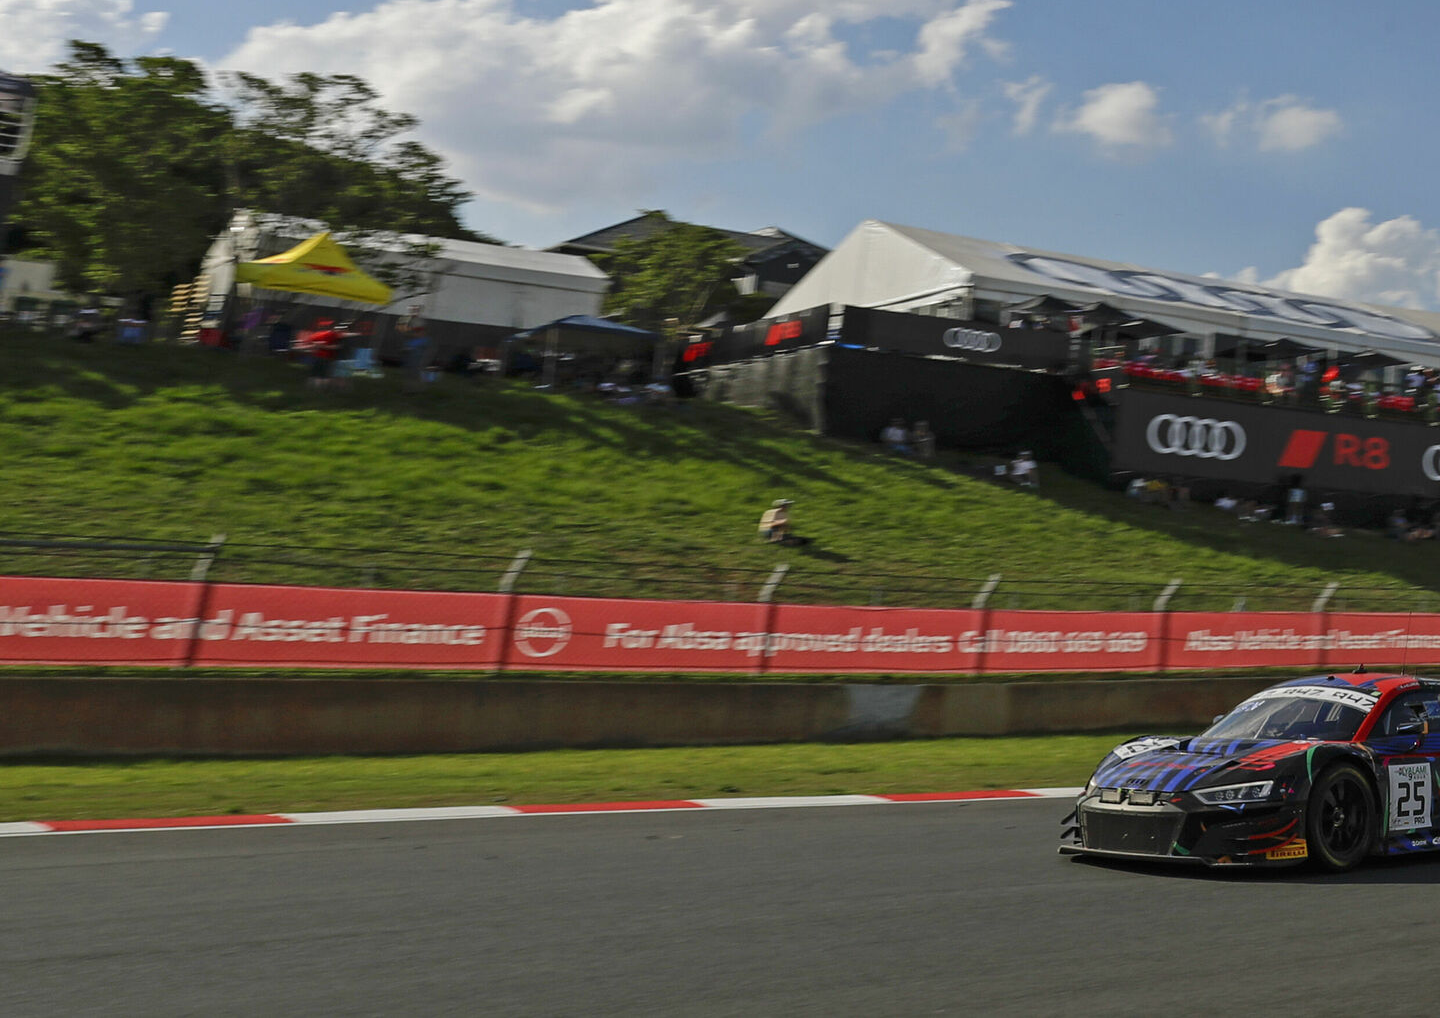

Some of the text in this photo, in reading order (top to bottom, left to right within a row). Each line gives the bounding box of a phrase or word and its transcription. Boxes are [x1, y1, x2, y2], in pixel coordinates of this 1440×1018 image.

[1334, 434, 1390, 469] R8
[0, 605, 486, 645] Vehicle and Asset Finance
[604, 623, 659, 649] For
[656, 623, 732, 650] Absa
[733, 628, 862, 657] approved
[861, 627, 953, 653] dealers
[958, 630, 1004, 653] Call
[1397, 781, 1425, 817] 25
